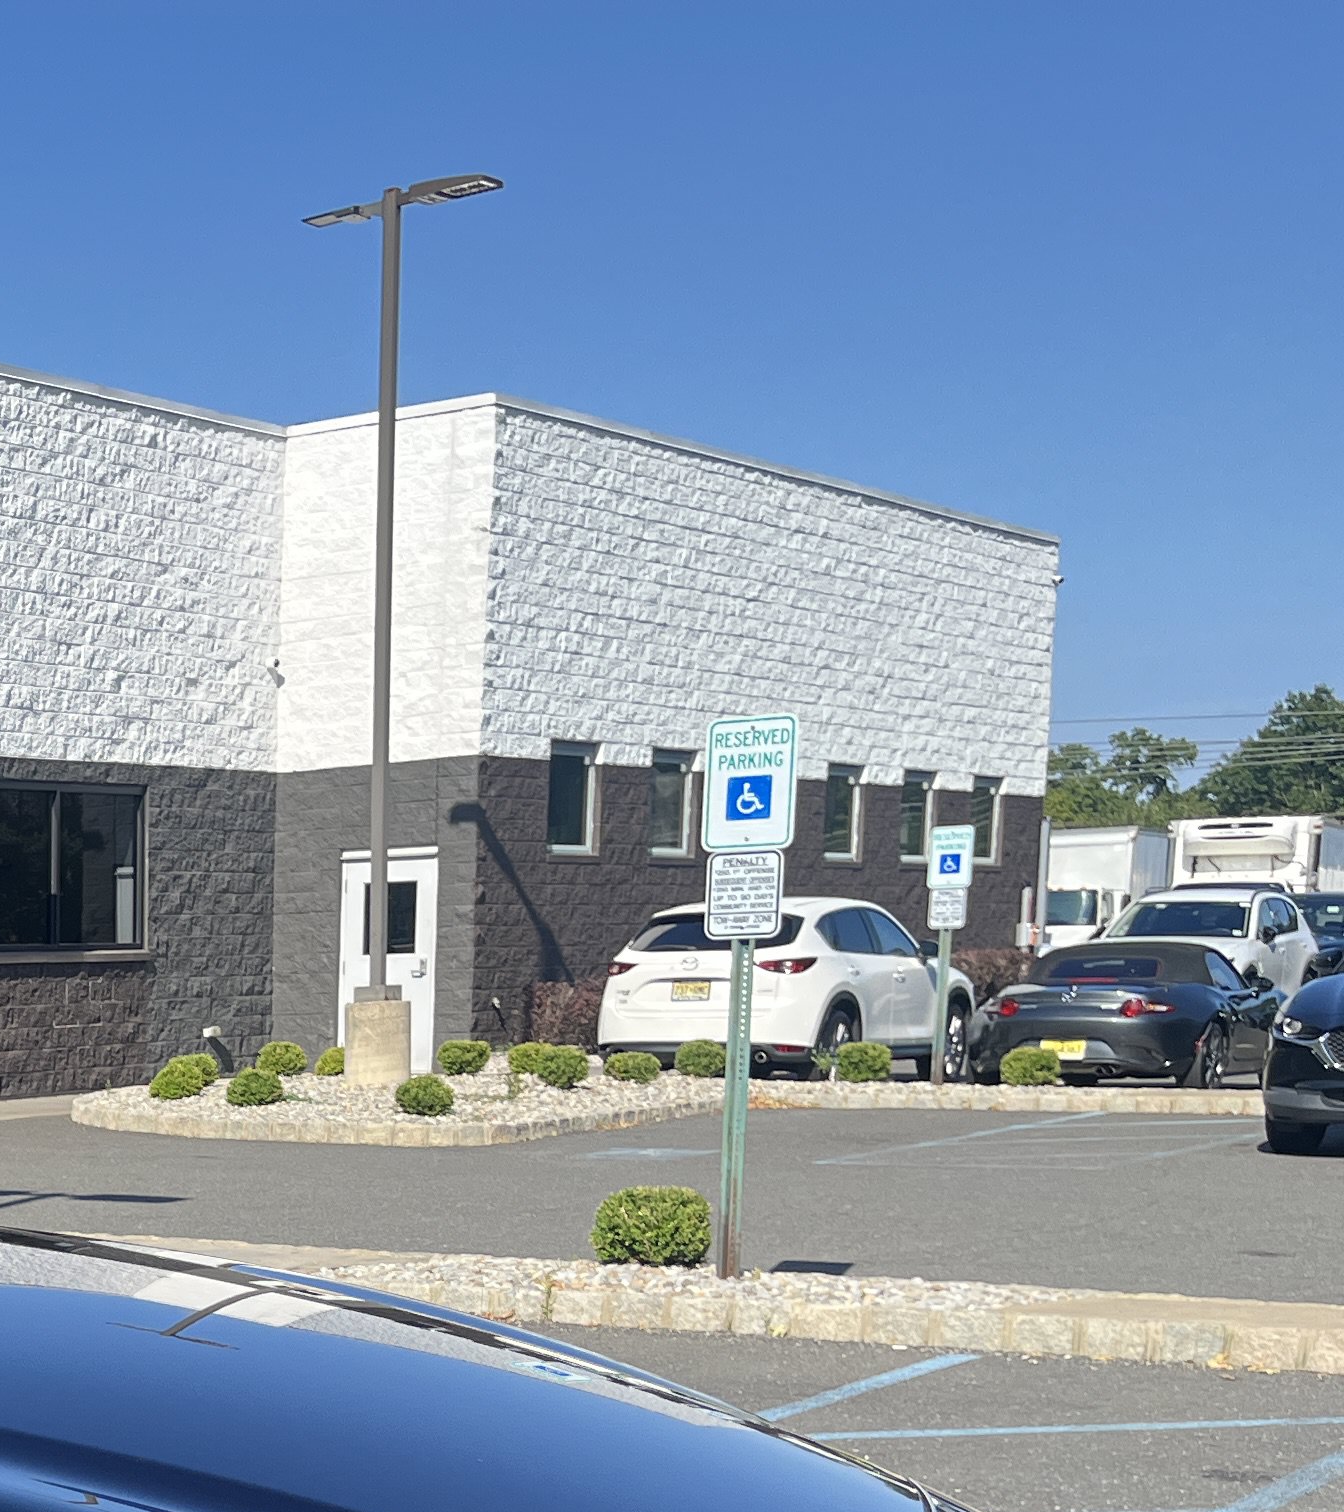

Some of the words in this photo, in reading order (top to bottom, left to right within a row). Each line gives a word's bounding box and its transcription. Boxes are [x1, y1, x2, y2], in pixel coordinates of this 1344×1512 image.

[715, 728, 790, 749] RESERVED
[718, 751, 783, 771] PARKING
[723, 856, 768, 867] PENALTY
